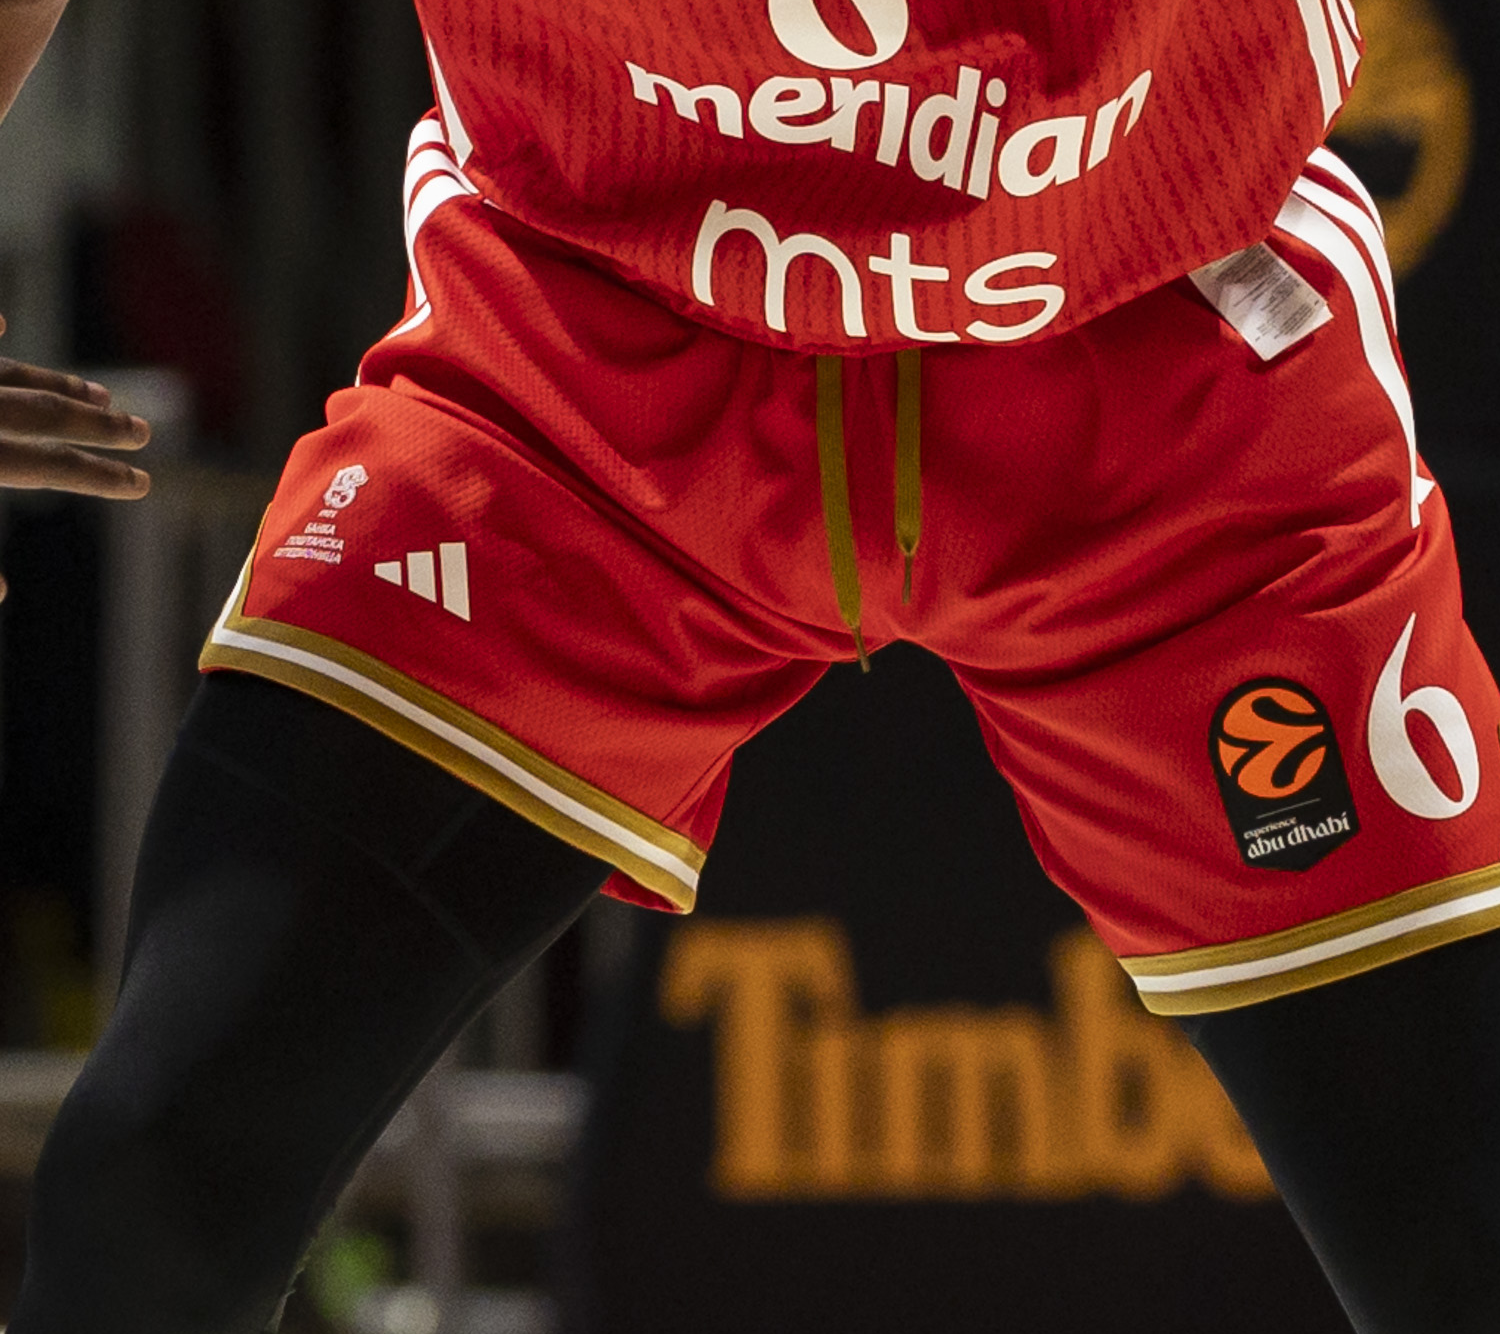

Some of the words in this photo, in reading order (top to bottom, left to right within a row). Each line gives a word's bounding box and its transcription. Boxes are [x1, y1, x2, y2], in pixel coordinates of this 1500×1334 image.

[625, 59, 1153, 200] meridian
[691, 198, 1066, 343] mts
[1366, 612, 1479, 820] 6
[1243, 817, 1297, 838] experience
[1246, 834, 1287, 860] abu
[1286, 810, 1352, 847] dhabi
